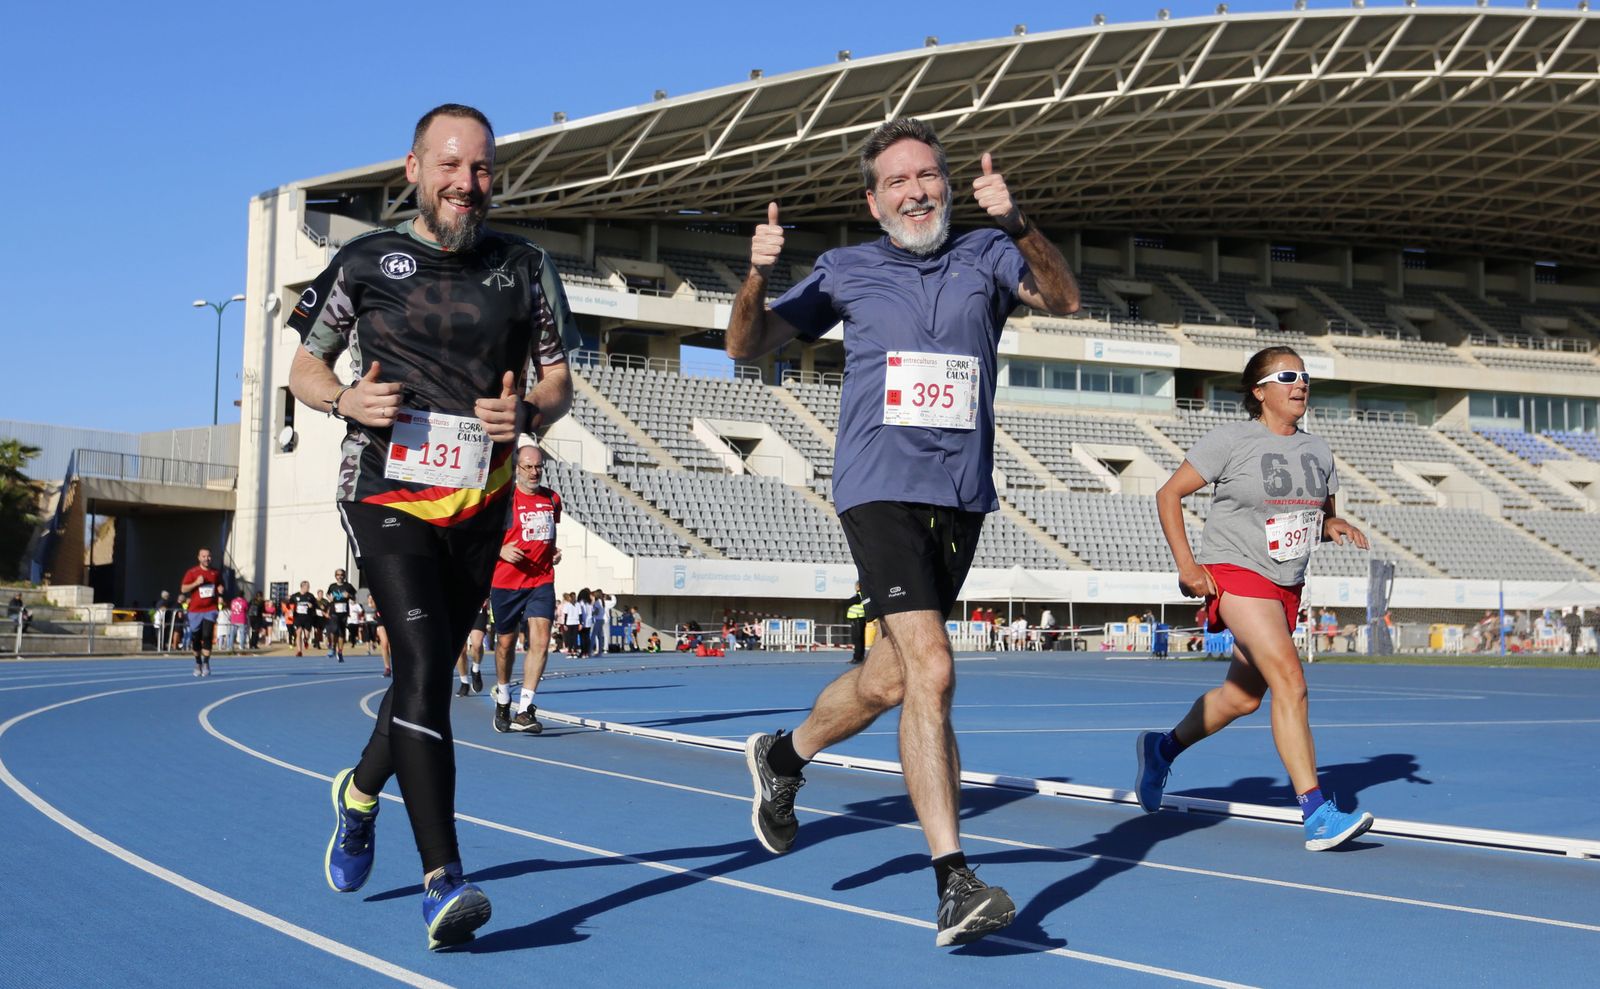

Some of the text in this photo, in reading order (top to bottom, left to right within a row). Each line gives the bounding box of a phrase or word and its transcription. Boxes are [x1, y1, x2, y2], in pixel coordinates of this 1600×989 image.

[946, 371, 969, 380] CAUSA
[912, 382, 954, 408] 395
[457, 432, 483, 443] CAUSA
[418, 442, 463, 470] 131
[1261, 453, 1327, 497] 6.0
[536, 524, 550, 534] 265
[1284, 527, 1309, 548] 397
